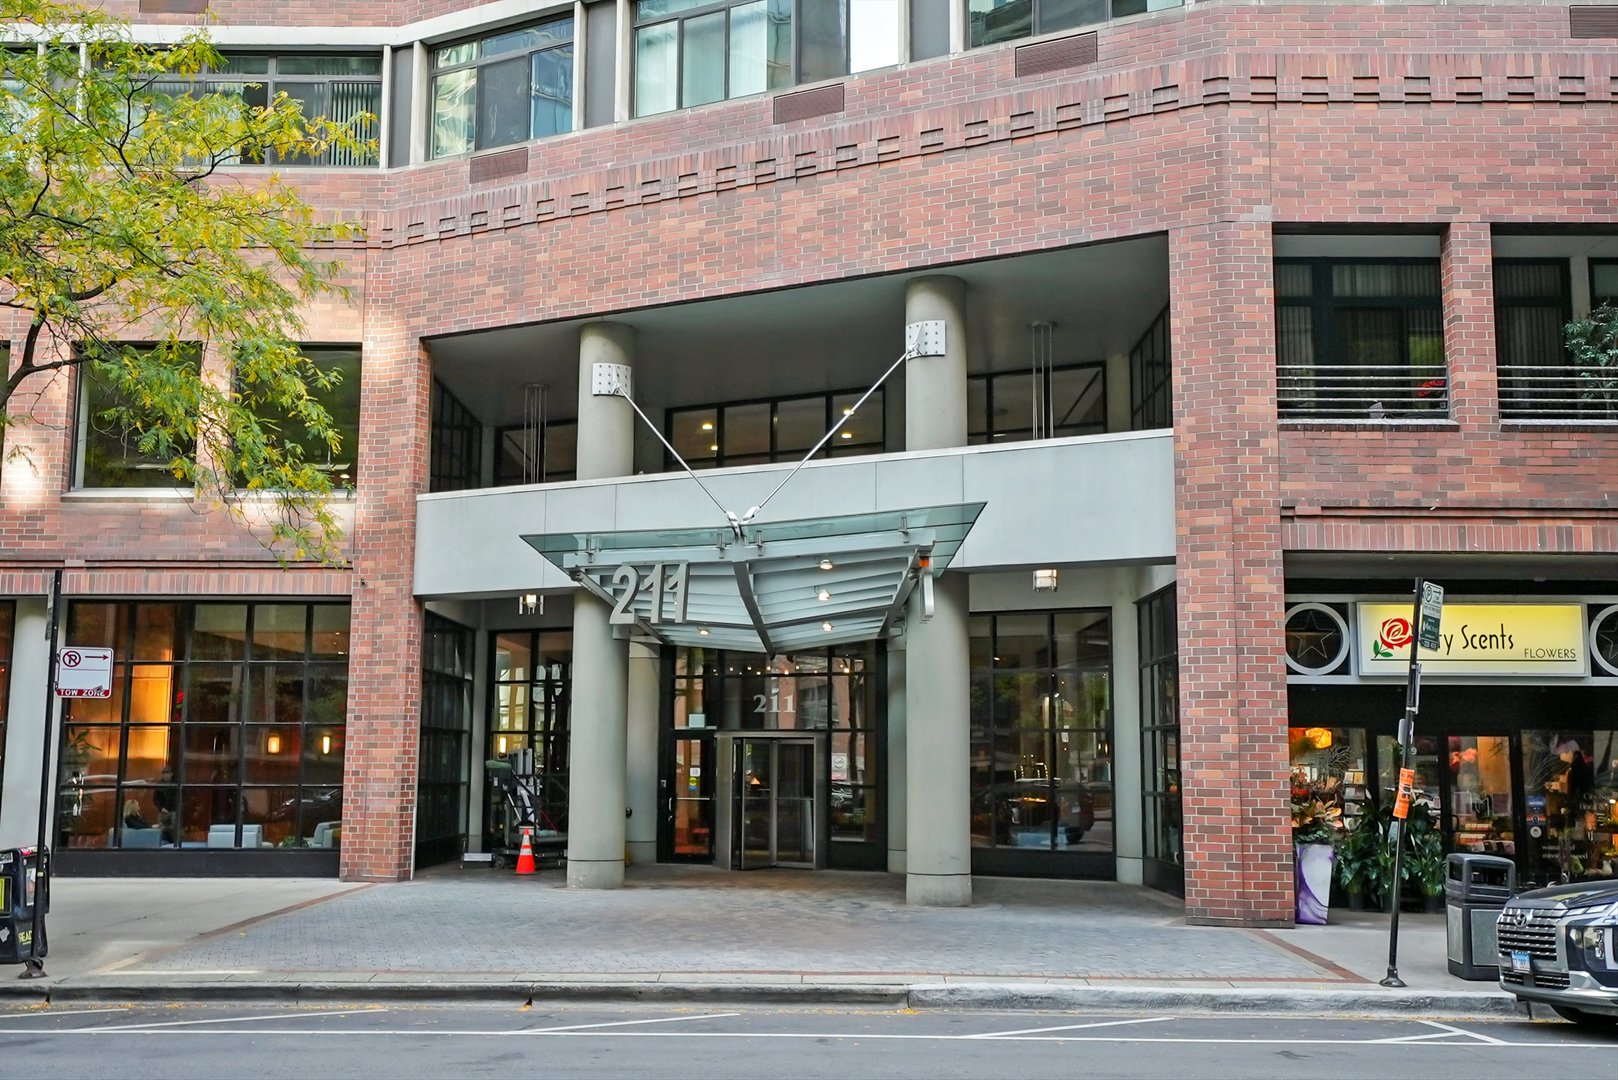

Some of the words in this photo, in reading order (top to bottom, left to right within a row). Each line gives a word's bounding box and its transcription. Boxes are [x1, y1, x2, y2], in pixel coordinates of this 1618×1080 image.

[609, 563, 688, 624] 211
[1461, 623, 1514, 650] Scents
[1524, 648, 1576, 658] FLOWERS
[753, 695, 796, 713] 211
